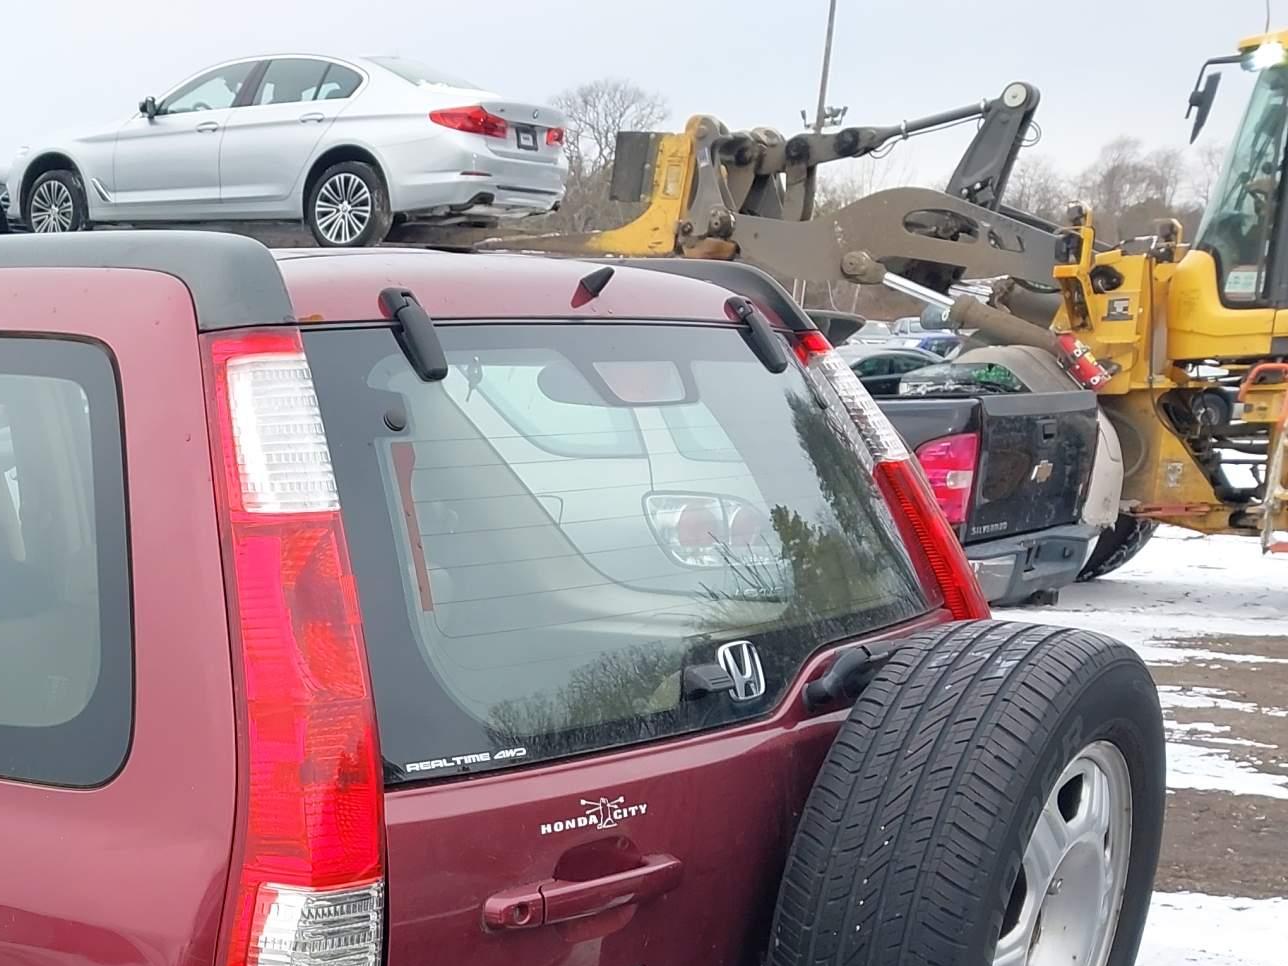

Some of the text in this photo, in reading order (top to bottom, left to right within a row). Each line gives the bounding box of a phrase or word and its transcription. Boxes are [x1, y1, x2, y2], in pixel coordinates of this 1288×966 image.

[406, 752, 491, 773] REALTIME
[540, 803, 648, 835] HONDA CITY
